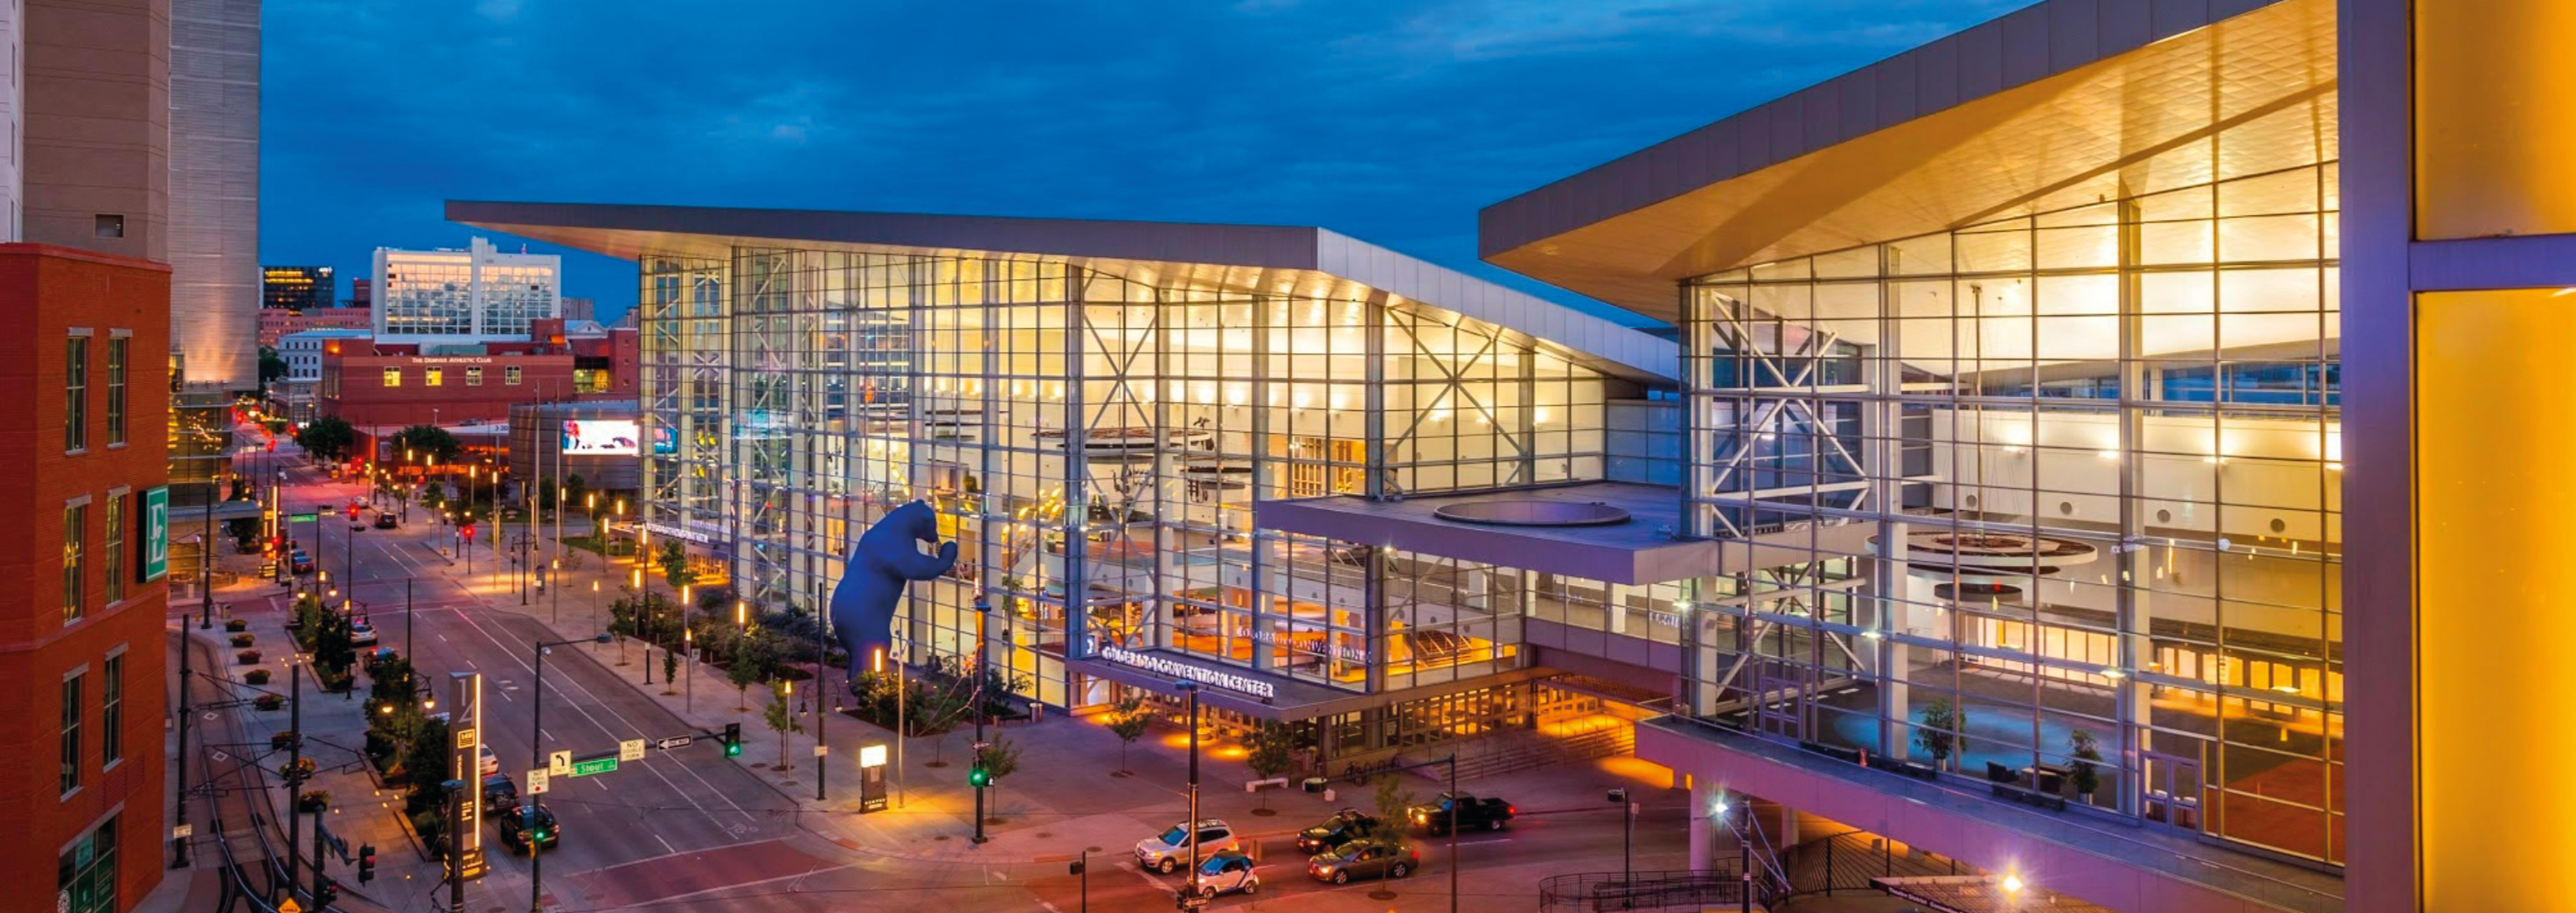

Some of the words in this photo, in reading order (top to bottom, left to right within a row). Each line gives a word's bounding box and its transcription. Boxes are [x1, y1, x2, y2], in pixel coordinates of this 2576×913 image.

[1102, 646, 1158, 671] COLORADO
[1159, 659, 1229, 689] CONVENTION
[1229, 675, 1274, 698] CENTER
[580, 763, 604, 774] Stout
